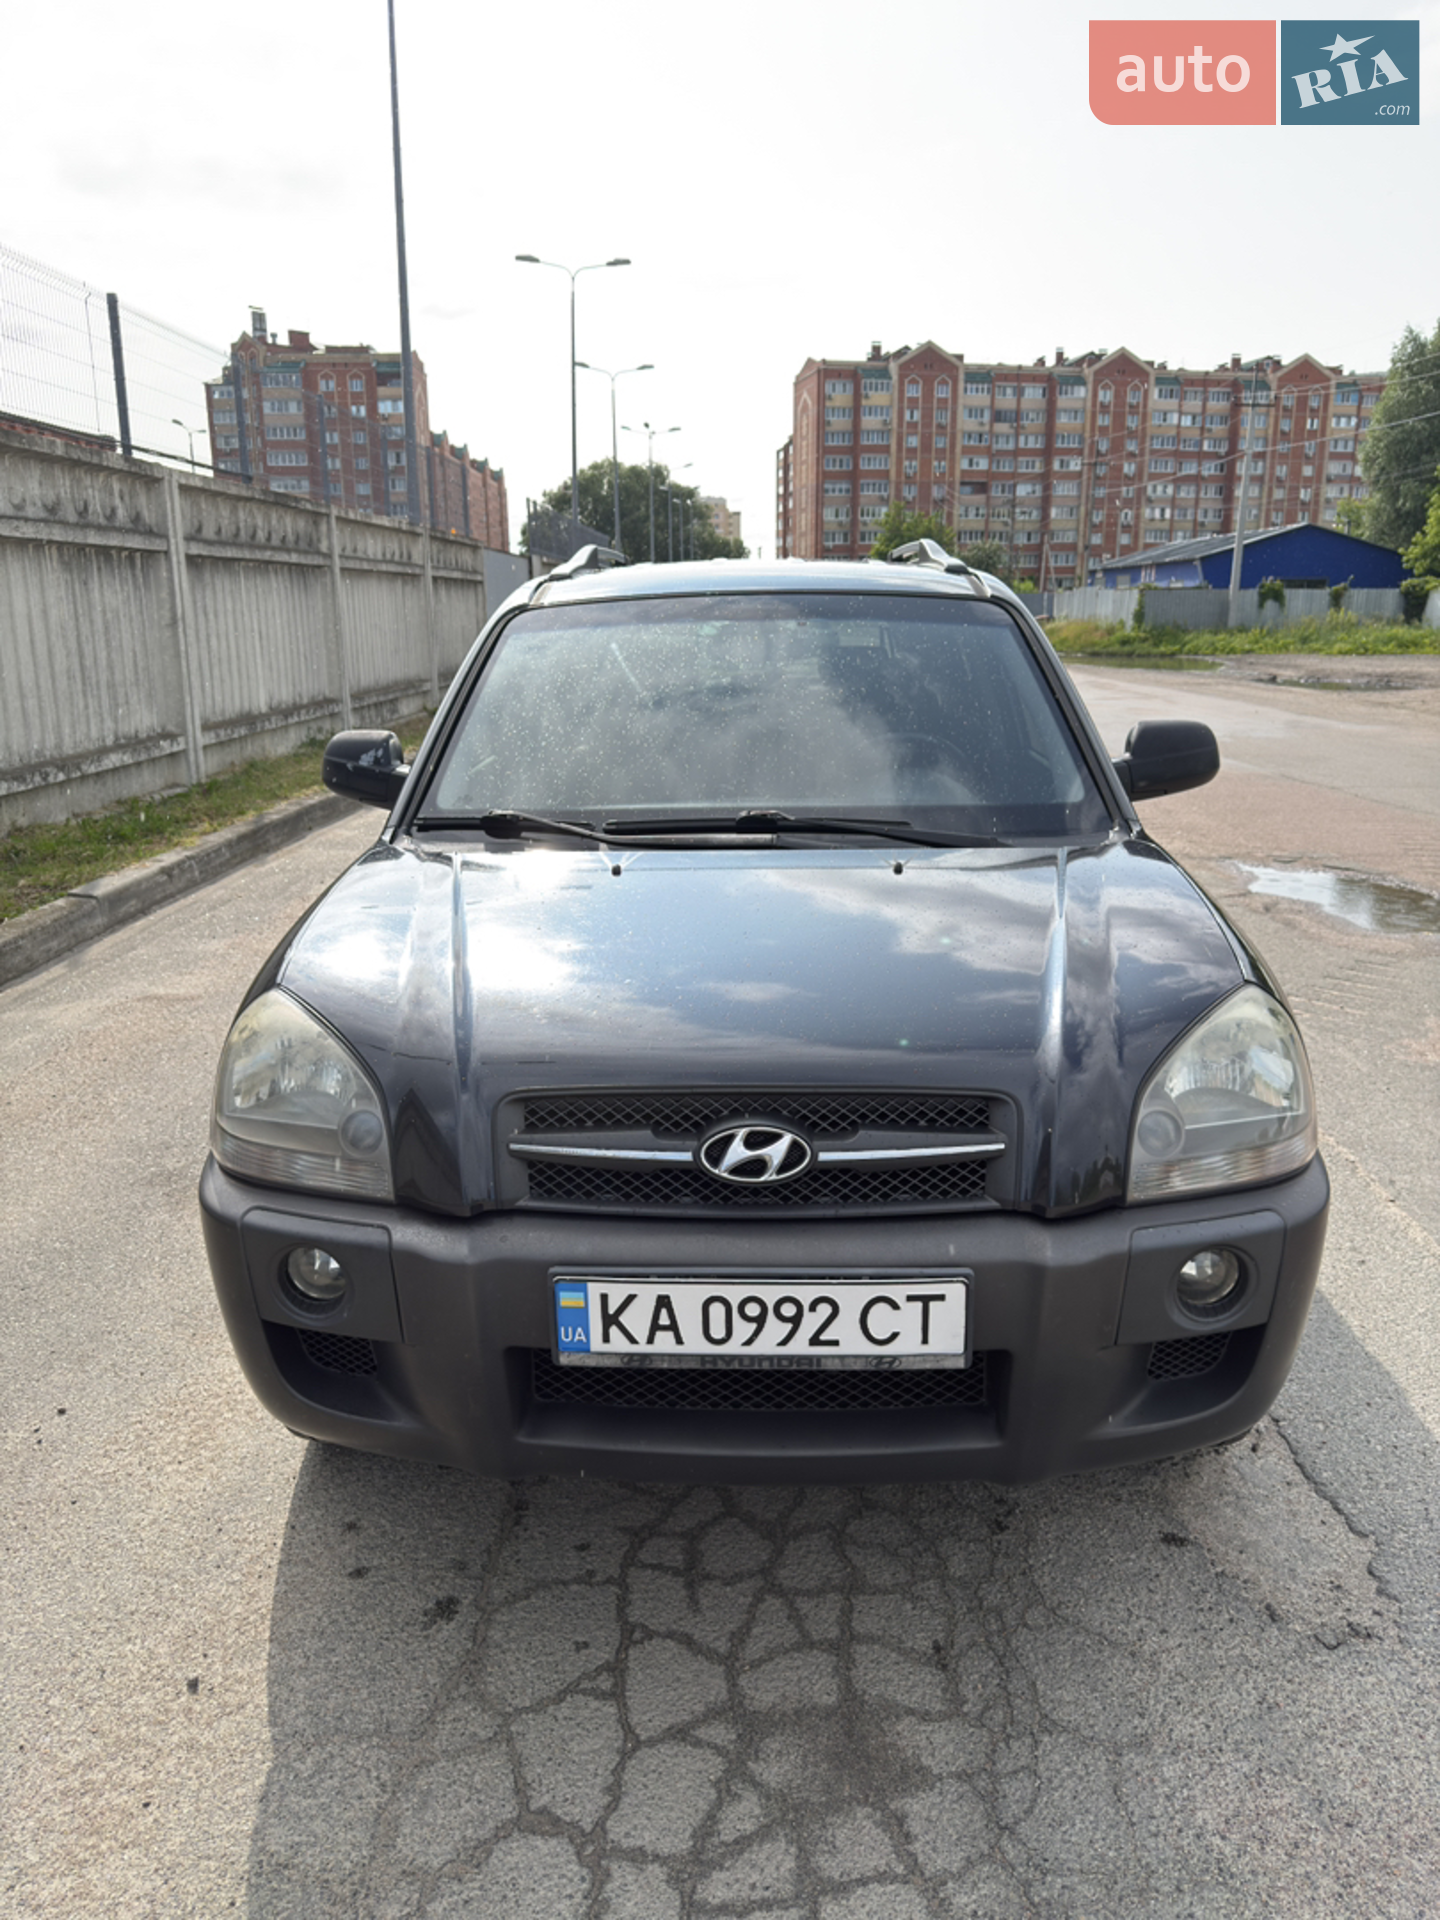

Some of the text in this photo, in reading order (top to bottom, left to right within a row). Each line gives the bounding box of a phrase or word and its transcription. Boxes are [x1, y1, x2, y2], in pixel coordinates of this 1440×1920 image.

[600, 1292, 947, 1347] KA 0992 CT
[561, 1326, 588, 1344] UA
[700, 1355, 823, 1369] HYUNDAI
